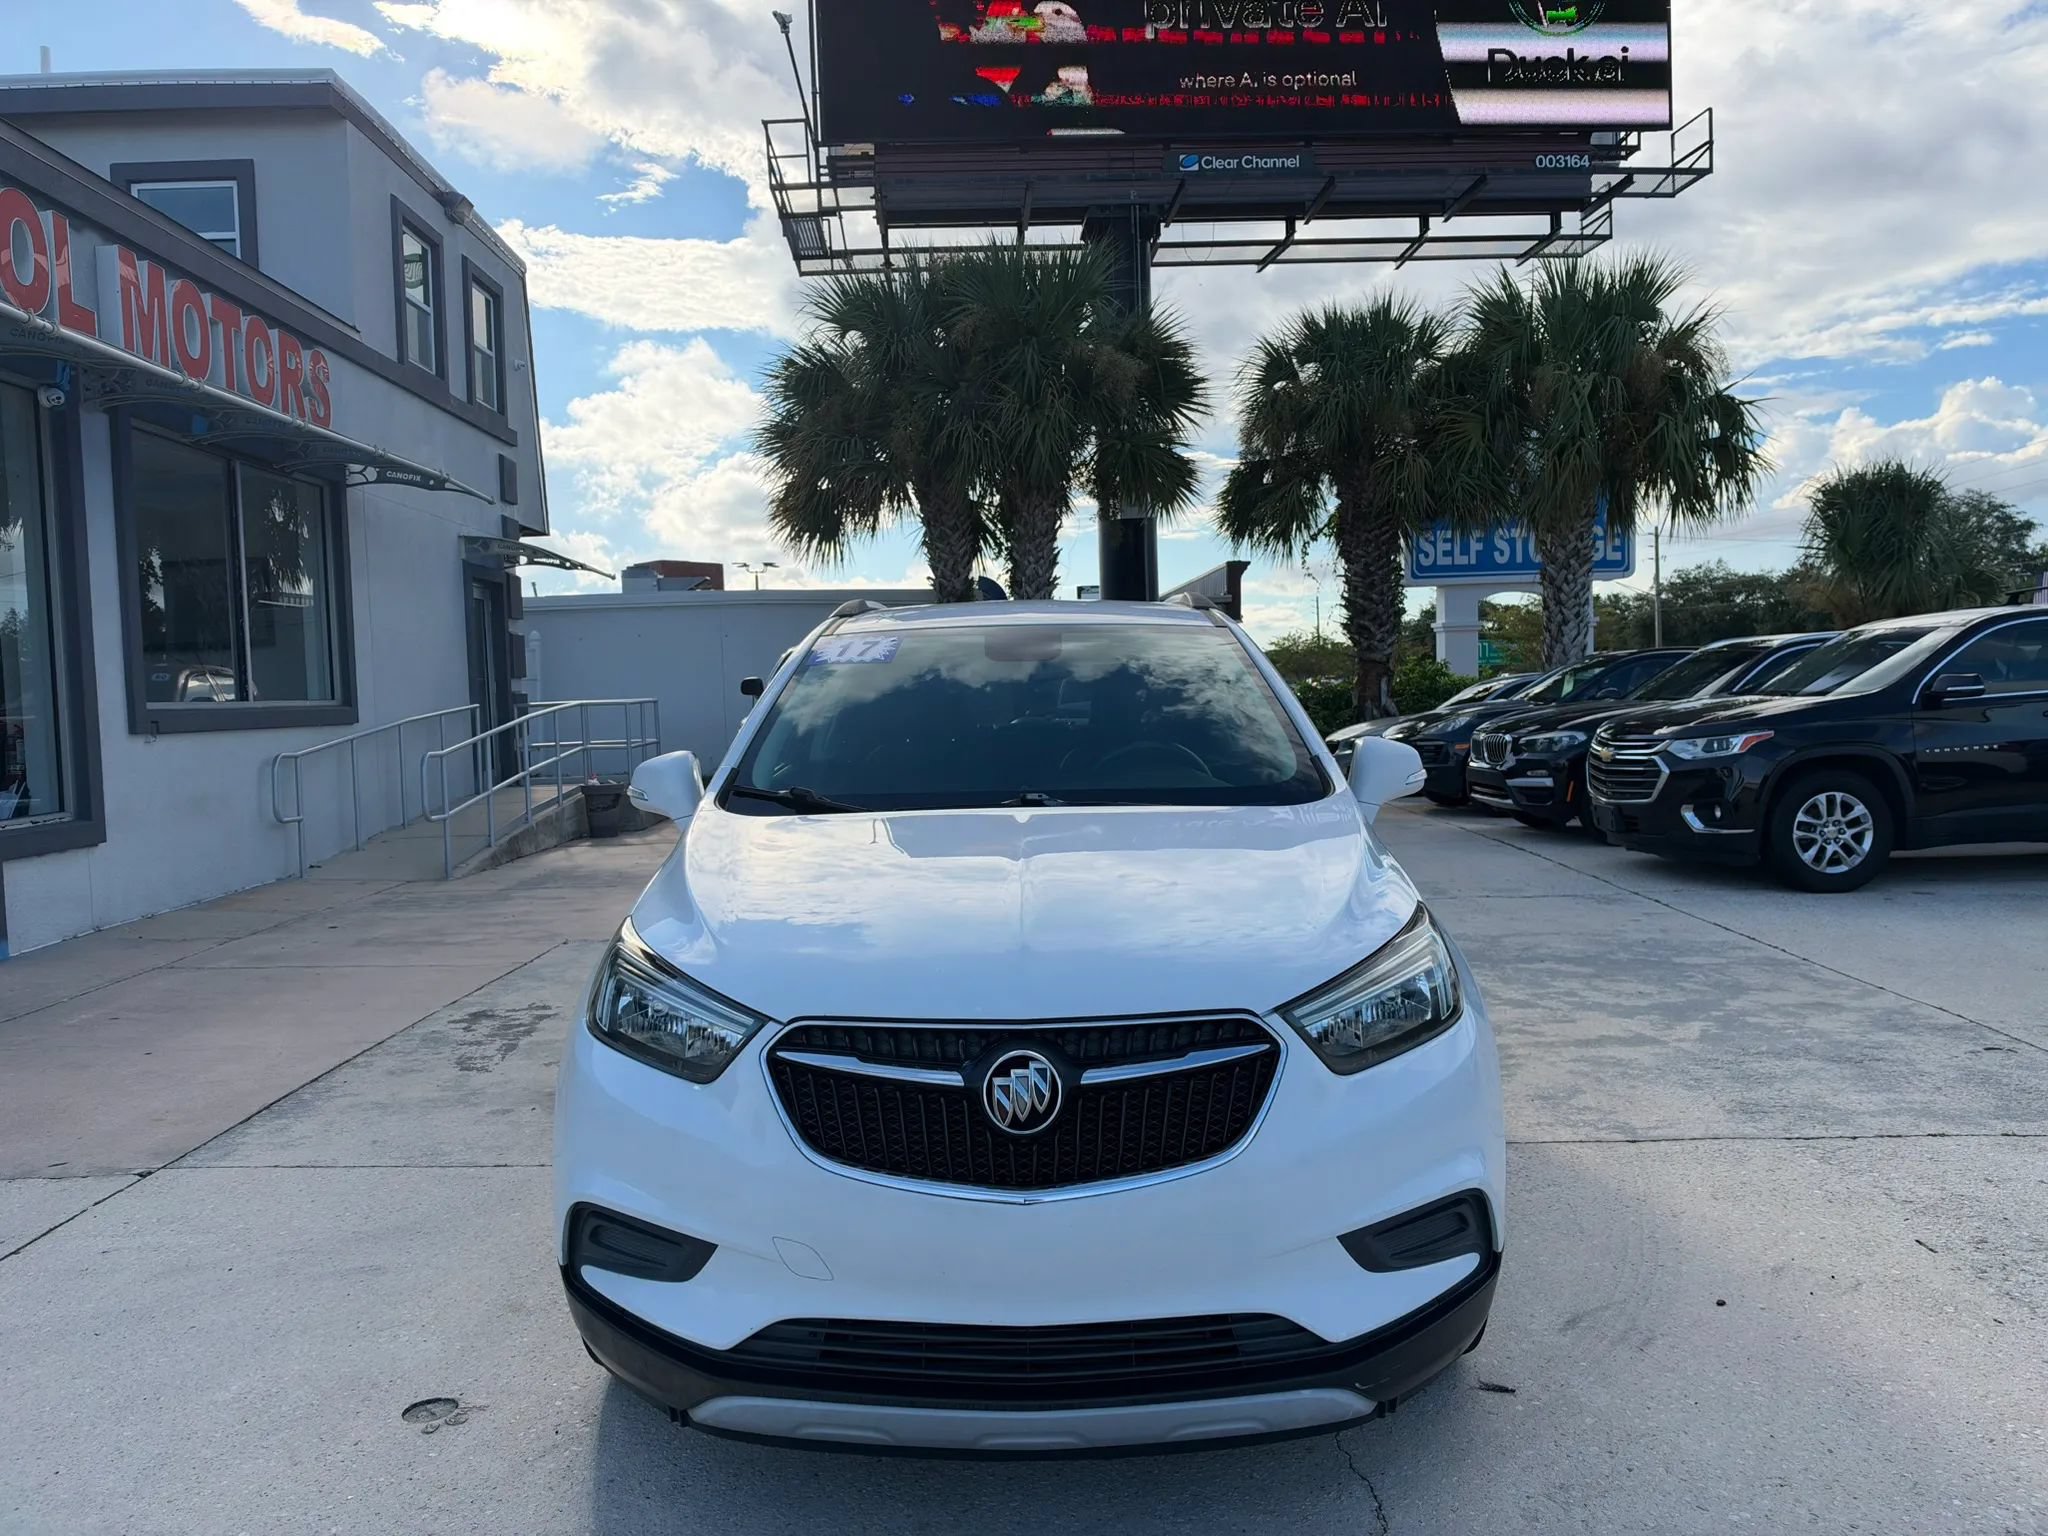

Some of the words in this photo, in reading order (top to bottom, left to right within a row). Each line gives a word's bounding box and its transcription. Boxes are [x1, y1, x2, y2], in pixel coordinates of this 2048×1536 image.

[1145, 0, 1324, 39] private
[1180, 73, 1236, 89] where
[1263, 71, 1277, 88] is
[1282, 71, 1358, 91] optional
[1201, 156, 1239, 169] Clear
[1241, 154, 1300, 169] Channel
[1535, 154, 1590, 168] 003164
[0, 186, 97, 338] OL
[116, 243, 333, 429] MOTORS
[386, 470, 422, 482] CANOFIX
[1417, 528, 1484, 567] SELF
[1493, 526, 1622, 565] STOGE
[836, 640, 882, 658] 17
